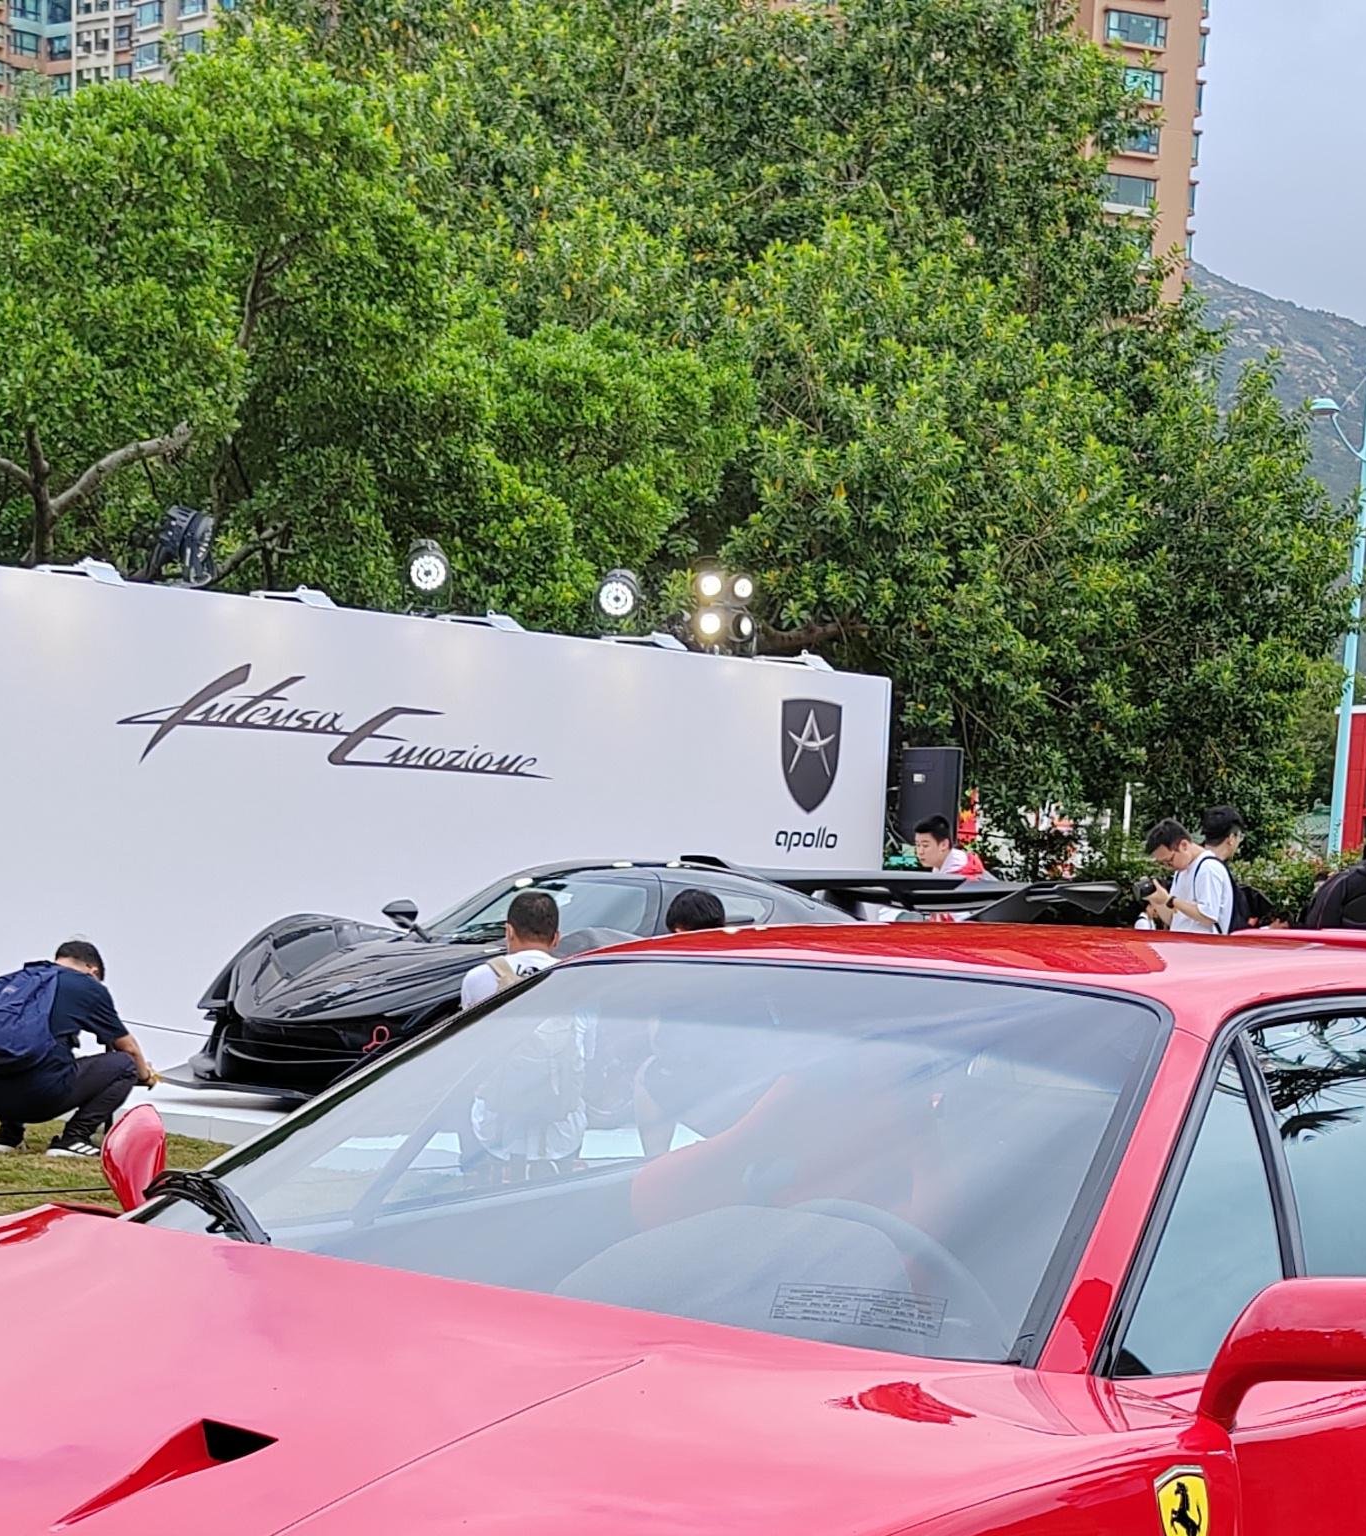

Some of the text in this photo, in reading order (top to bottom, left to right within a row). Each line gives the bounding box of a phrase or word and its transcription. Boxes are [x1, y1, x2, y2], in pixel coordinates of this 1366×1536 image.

[116, 663, 553, 779] Intensa Emozione
[775, 826, 838, 853] apollo
